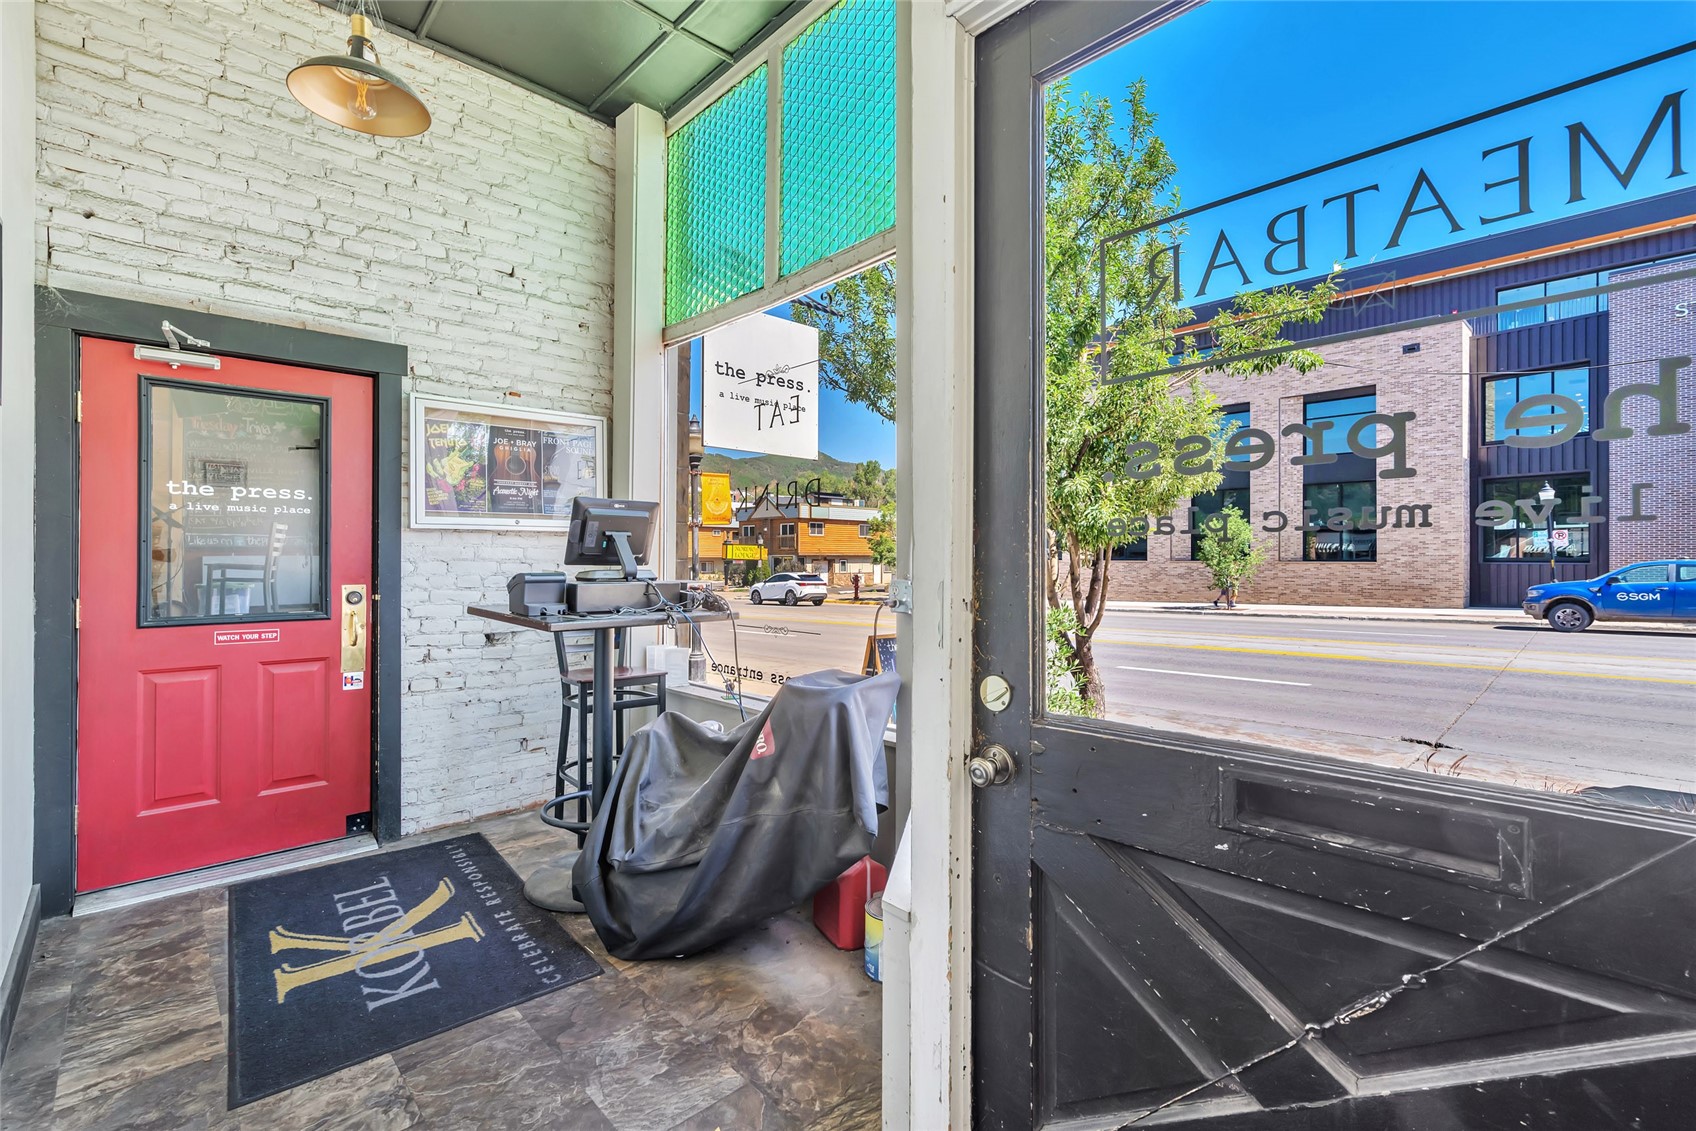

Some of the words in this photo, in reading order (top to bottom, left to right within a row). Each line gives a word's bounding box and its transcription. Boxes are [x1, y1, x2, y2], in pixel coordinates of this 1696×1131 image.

[1675, 300, 1696, 318] S
[714, 360, 746, 380] the
[756, 372, 811, 393] press.
[729, 392, 750, 403] live
[754, 397, 778, 408] music
[782, 402, 806, 414] place
[516, 440, 537, 448] BRAY
[166, 480, 214, 496] the
[230, 486, 313, 501] press.
[186, 502, 220, 511] live
[226, 504, 267, 513] music
[274, 506, 311, 515] place
[1628, 592, 1660, 601] SGM
[447, 844, 502, 906] RESPONSIBLY
[333, 875, 440, 1012] KORBEL
[493, 910, 562, 984] CELEBRATE
